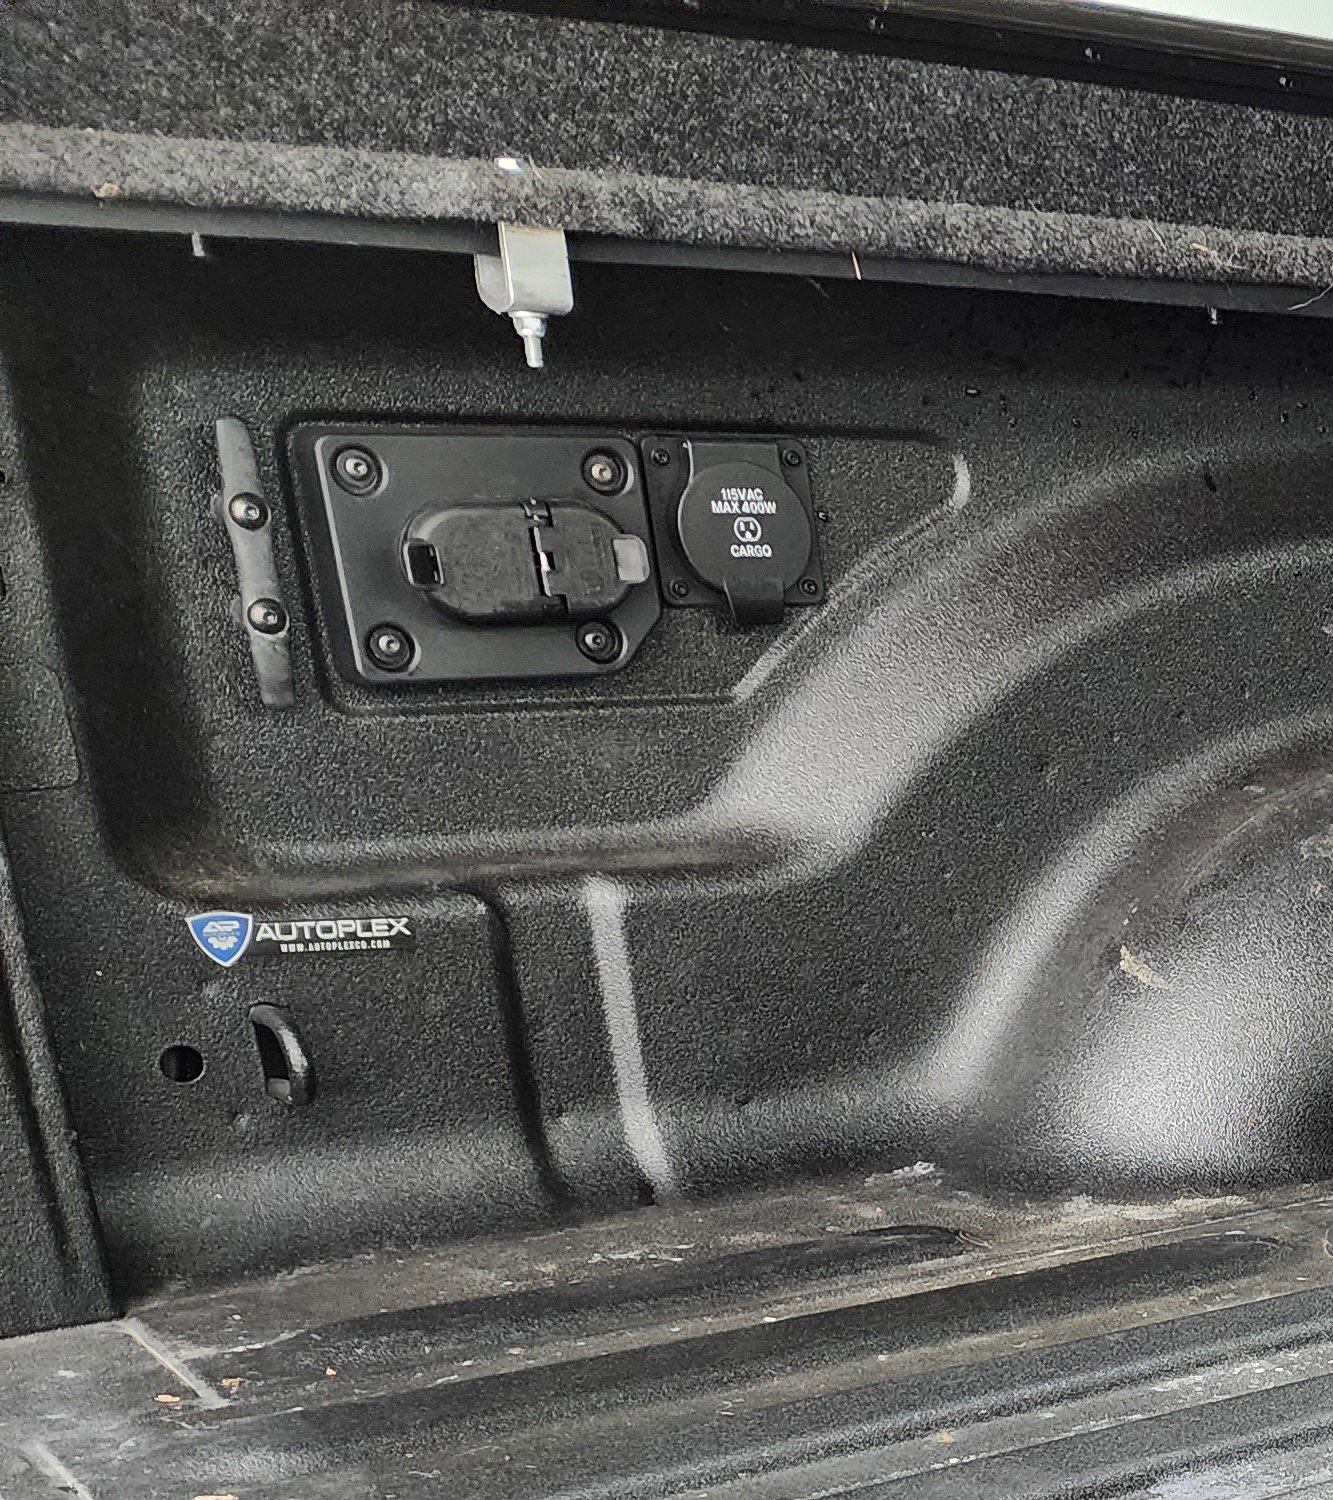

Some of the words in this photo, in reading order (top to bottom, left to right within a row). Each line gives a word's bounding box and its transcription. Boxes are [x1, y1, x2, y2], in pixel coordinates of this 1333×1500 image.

[720, 487, 764, 501] 115VAC
[711, 500, 740, 514] MAX
[742, 500, 777, 514] 400W
[730, 544, 773, 558] CARGO
[255, 916, 412, 942] AUTOPLEX
